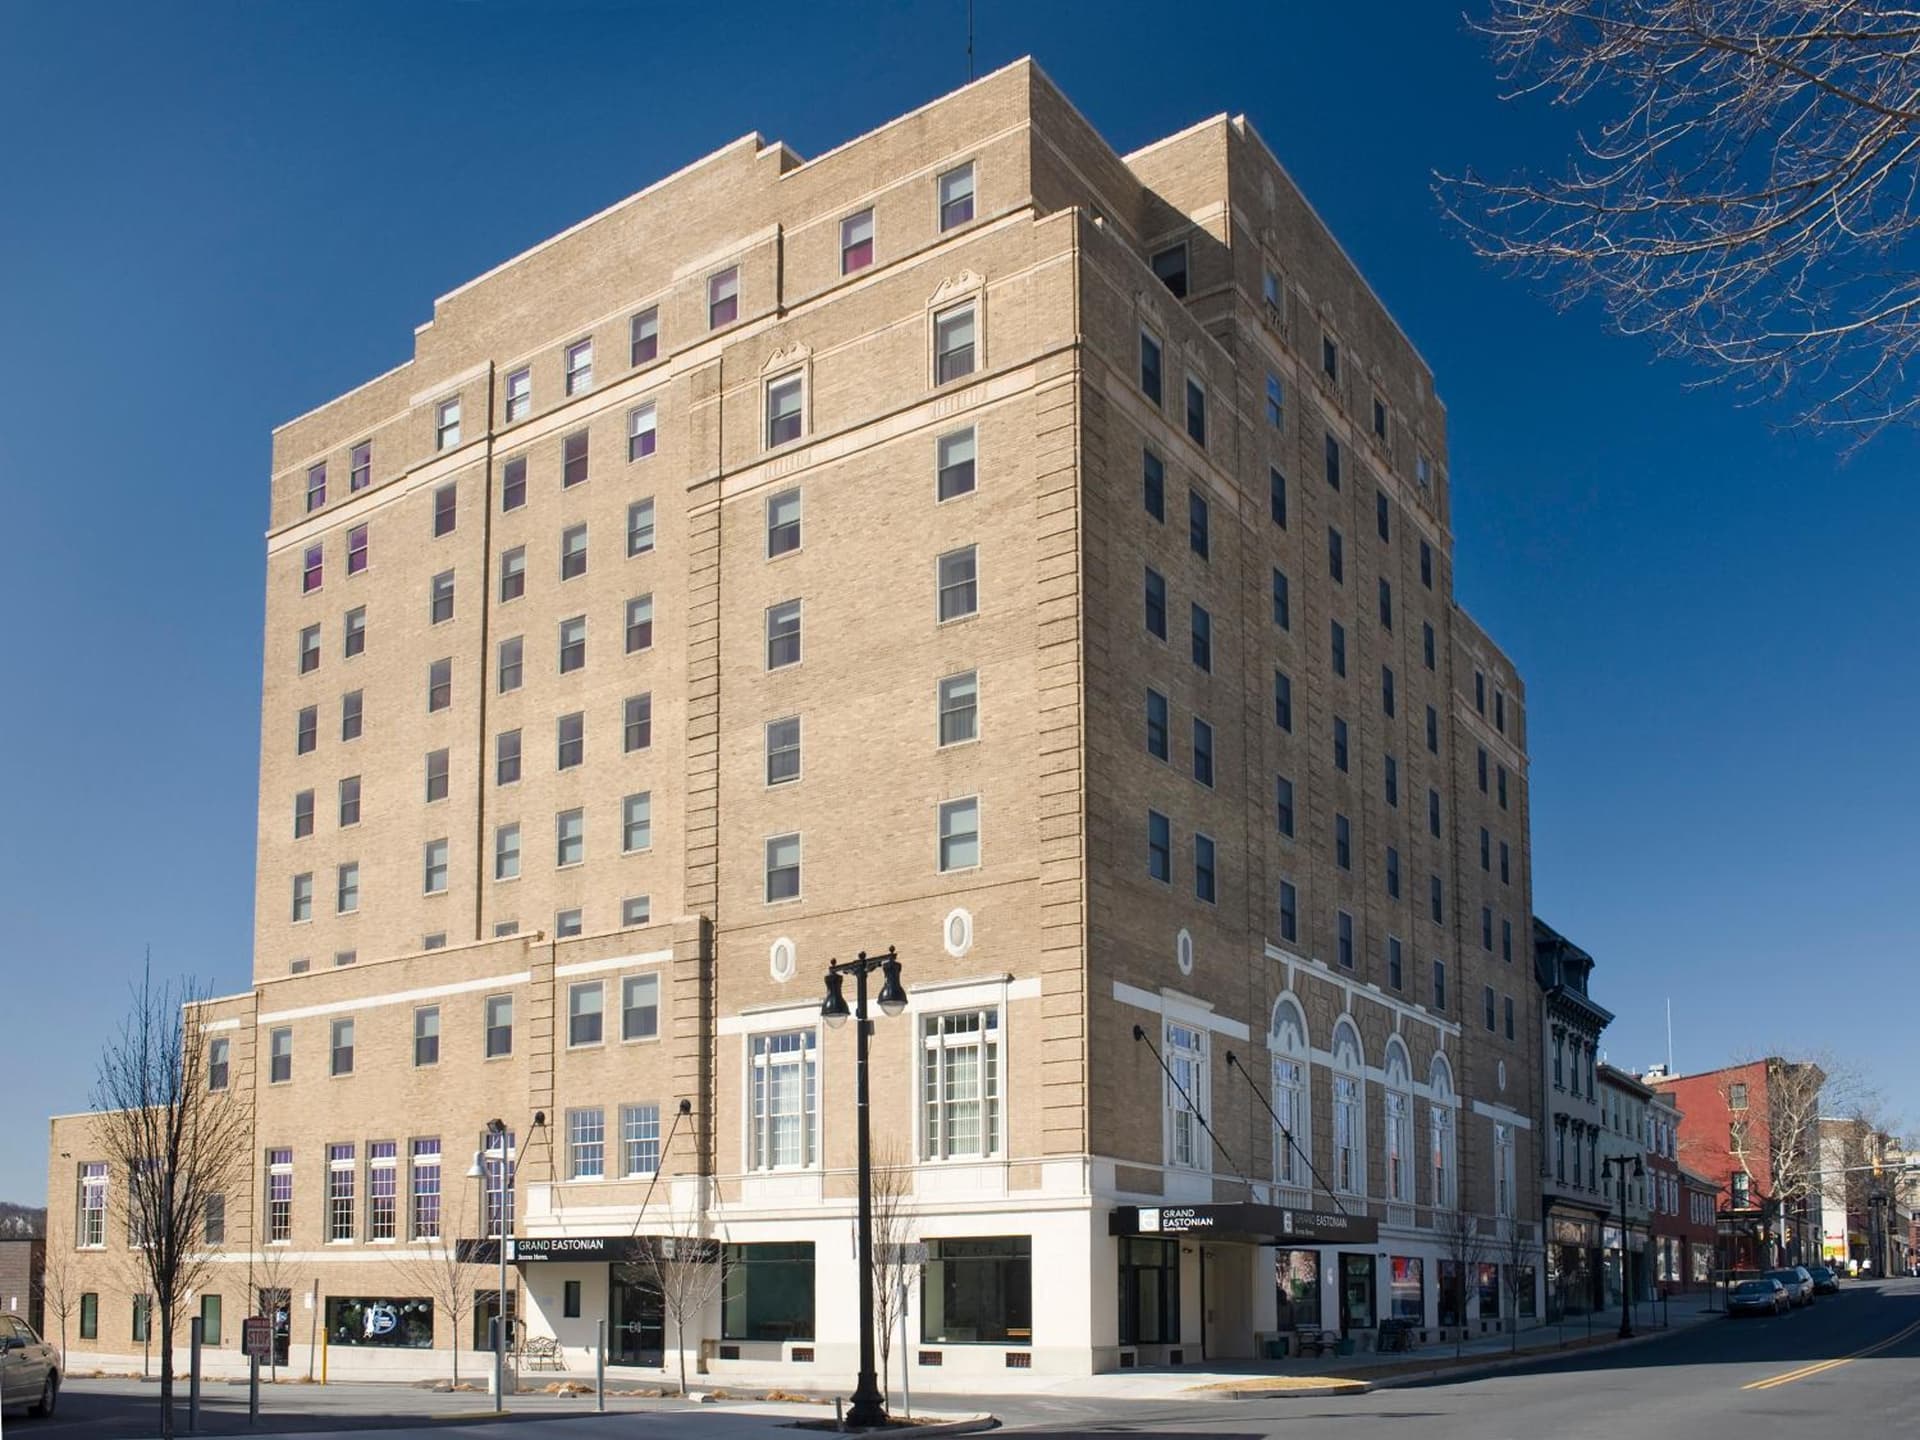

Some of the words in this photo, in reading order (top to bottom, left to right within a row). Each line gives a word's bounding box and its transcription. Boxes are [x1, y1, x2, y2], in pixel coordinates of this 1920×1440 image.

[1163, 1209, 1195, 1218] GRAND
[1163, 1218, 1213, 1228] EASTONIAN
[1317, 1215, 1347, 1228] EASTONIAN
[518, 1240, 550, 1250] GRAND
[551, 1239, 604, 1250] EASTONIAN
[248, 1331, 269, 1345] STOP
